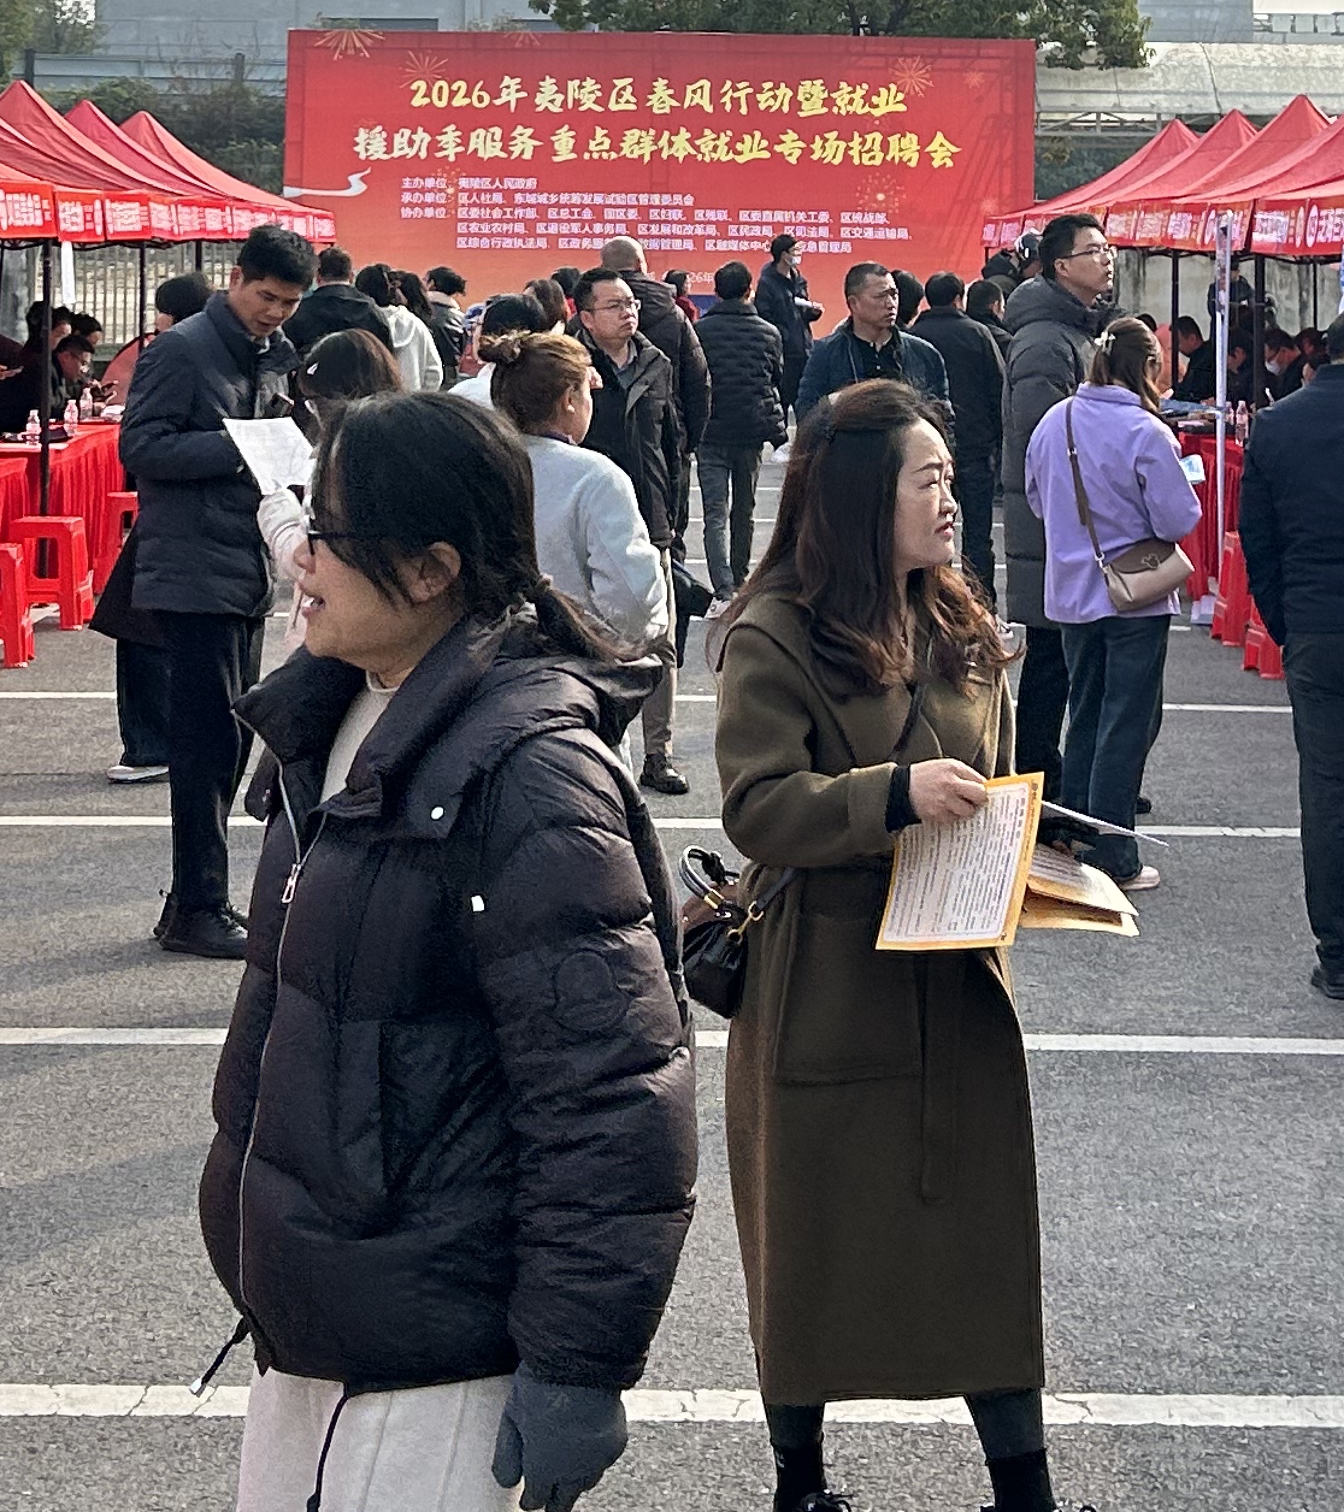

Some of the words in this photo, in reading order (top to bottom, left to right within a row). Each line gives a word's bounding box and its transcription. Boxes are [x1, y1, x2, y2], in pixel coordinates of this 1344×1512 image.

[410, 75, 908, 118] 2026年夷陵区春风行动暨就业
[353, 123, 962, 169] 援助季服务重点群体就业专场招聘会
